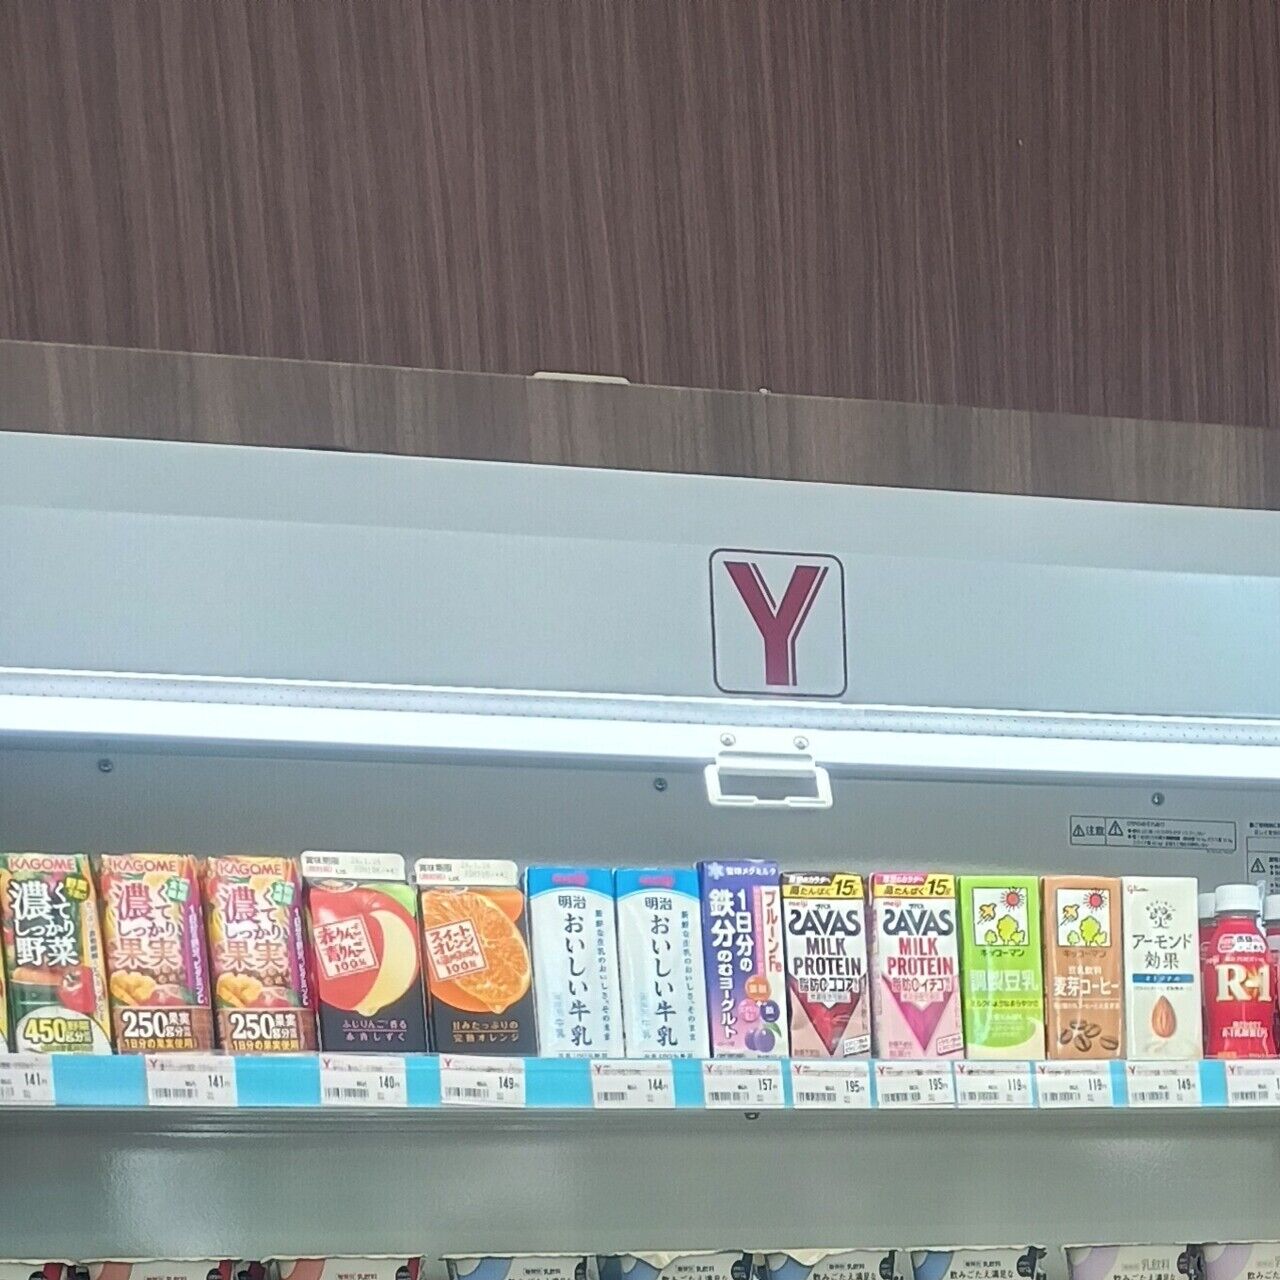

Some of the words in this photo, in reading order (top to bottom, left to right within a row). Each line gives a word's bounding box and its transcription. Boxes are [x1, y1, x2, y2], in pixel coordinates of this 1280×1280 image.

[723, 560, 828, 686] Y
[10, 858, 76, 872] KAGOME
[113, 859, 177, 872] KAGOME
[220, 861, 282, 876] KAGOME
[558, 895, 586, 910] 明治
[644, 896, 673, 911] 明治
[15, 920, 76, 938] しっかり
[117, 921, 178, 938] しっかり
[225, 923, 283, 940] しっかり
[734, 890, 755, 973] 1日分の
[788, 909, 862, 937] SAVAS
[882, 910, 955, 937] SAVAS
[16, 937, 80, 966] 野菜
[806, 937, 846, 956] MILK
[899, 937, 939, 956] MILK
[1131, 934, 1193, 950] アーモンド
[117, 938, 180, 968] 果実
[224, 940, 285, 970] 果実
[1144, 952, 1179, 970] 効果
[708, 888, 739, 1040] 鉄分のむヨーグルト
[793, 957, 862, 977] PROTEIN
[887, 957, 954, 977] PROTEIN
[563, 912, 592, 1048] おいしい牛乳
[650, 913, 678, 1049] おいしい牛乳
[1053, 976, 1120, 998] 麦芽コーヒー
[122, 1011, 167, 1038] 250
[230, 1013, 274, 1040] 250
